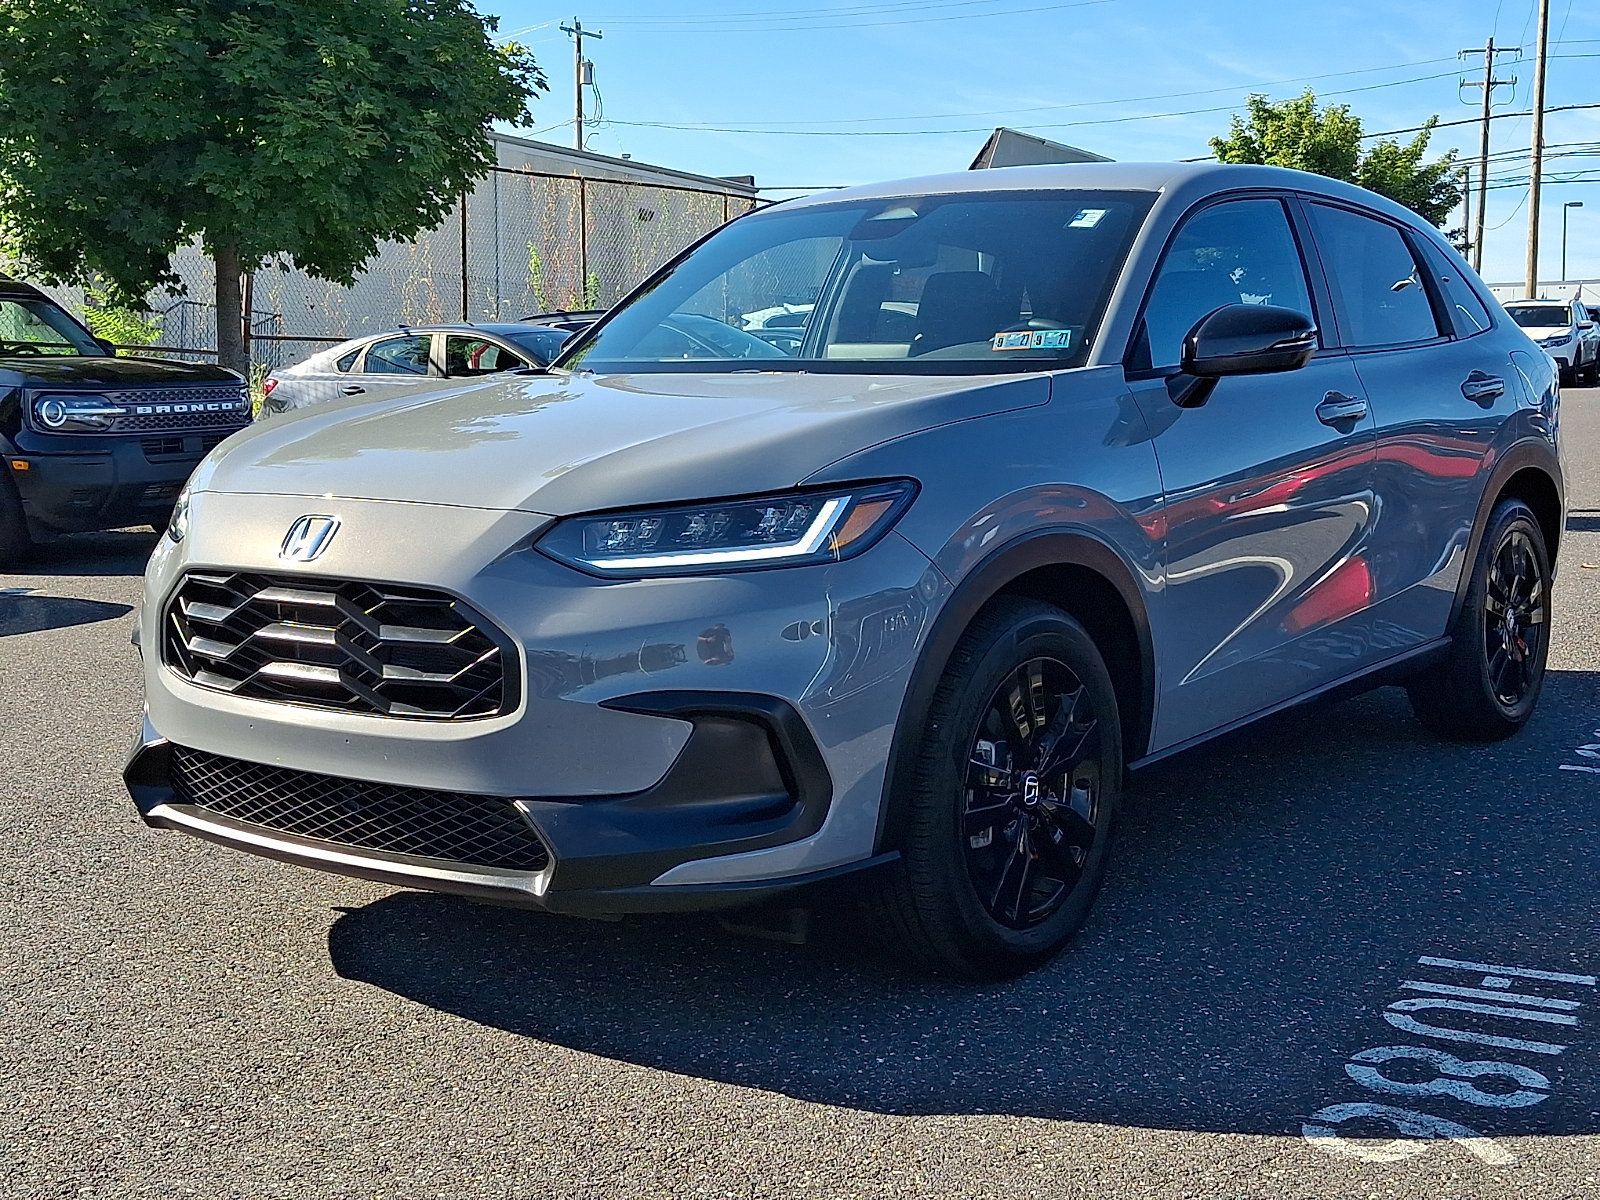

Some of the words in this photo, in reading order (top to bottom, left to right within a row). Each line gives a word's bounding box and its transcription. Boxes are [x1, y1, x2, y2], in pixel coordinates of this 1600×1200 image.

[997, 337, 1004, 348] 9
[1020, 334, 1030, 346] 27
[1035, 335, 1042, 346] 9
[1058, 333, 1068, 345] 27
[137, 402, 233, 414] BRONCO
